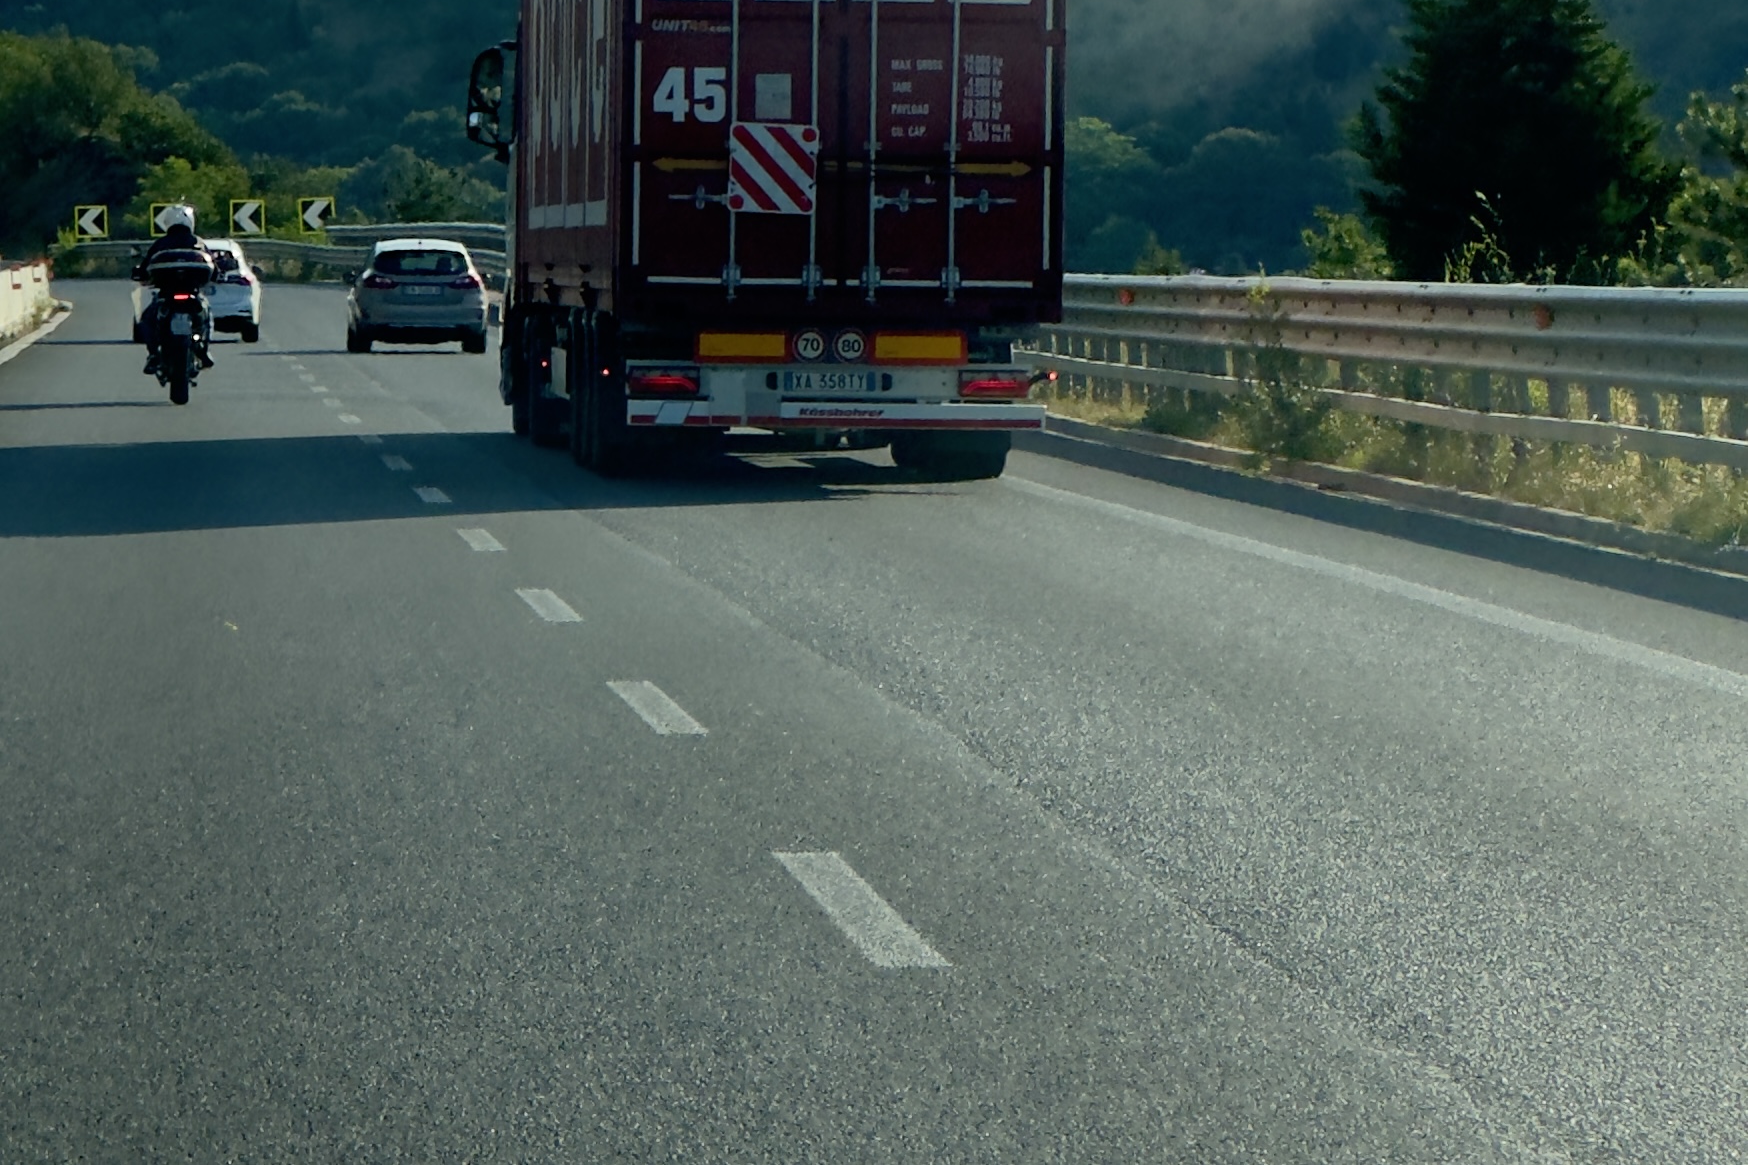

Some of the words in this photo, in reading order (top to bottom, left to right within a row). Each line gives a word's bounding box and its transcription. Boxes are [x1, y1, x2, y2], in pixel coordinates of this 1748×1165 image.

[891, 59, 912, 71] MAX
[653, 66, 727, 123] 45
[891, 103, 930, 115] PAYLOAD
[802, 338, 821, 352] 70
[841, 339, 862, 353] 80
[795, 374, 812, 389] XA
[819, 374, 864, 389] 358TY
